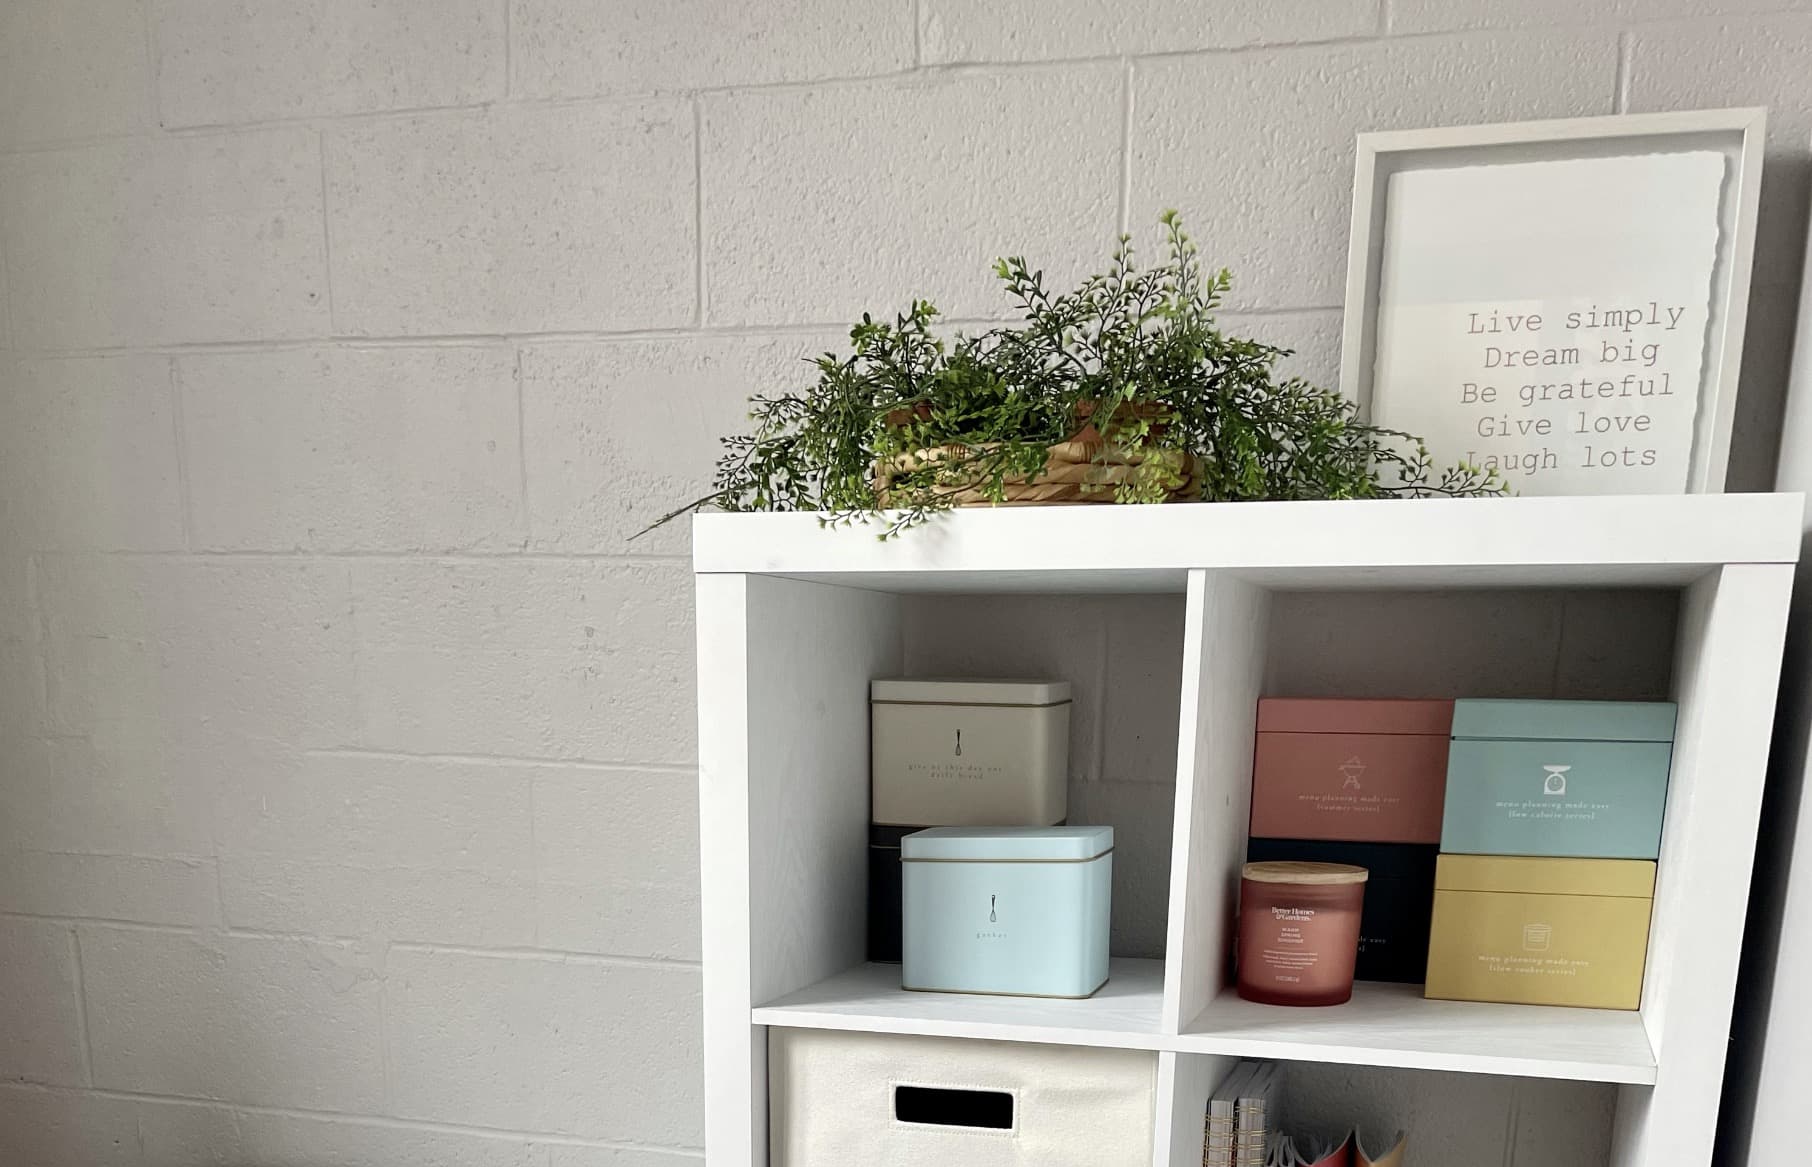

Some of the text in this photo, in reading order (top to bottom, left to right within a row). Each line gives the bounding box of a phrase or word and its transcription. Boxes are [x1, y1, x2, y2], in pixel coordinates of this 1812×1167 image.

[1467, 302, 1685, 335] Live simply
[1484, 339, 1661, 368] Dream big
[1460, 373, 1674, 407] Be grateful
[1477, 411, 1652, 437] Give love
[1466, 446, 1657, 476] Laugh lots
[1522, 800, 1562, 810] planning
[1565, 800, 1588, 809] made
[1503, 954, 1543, 966] planning
[1545, 957, 1569, 965] made
